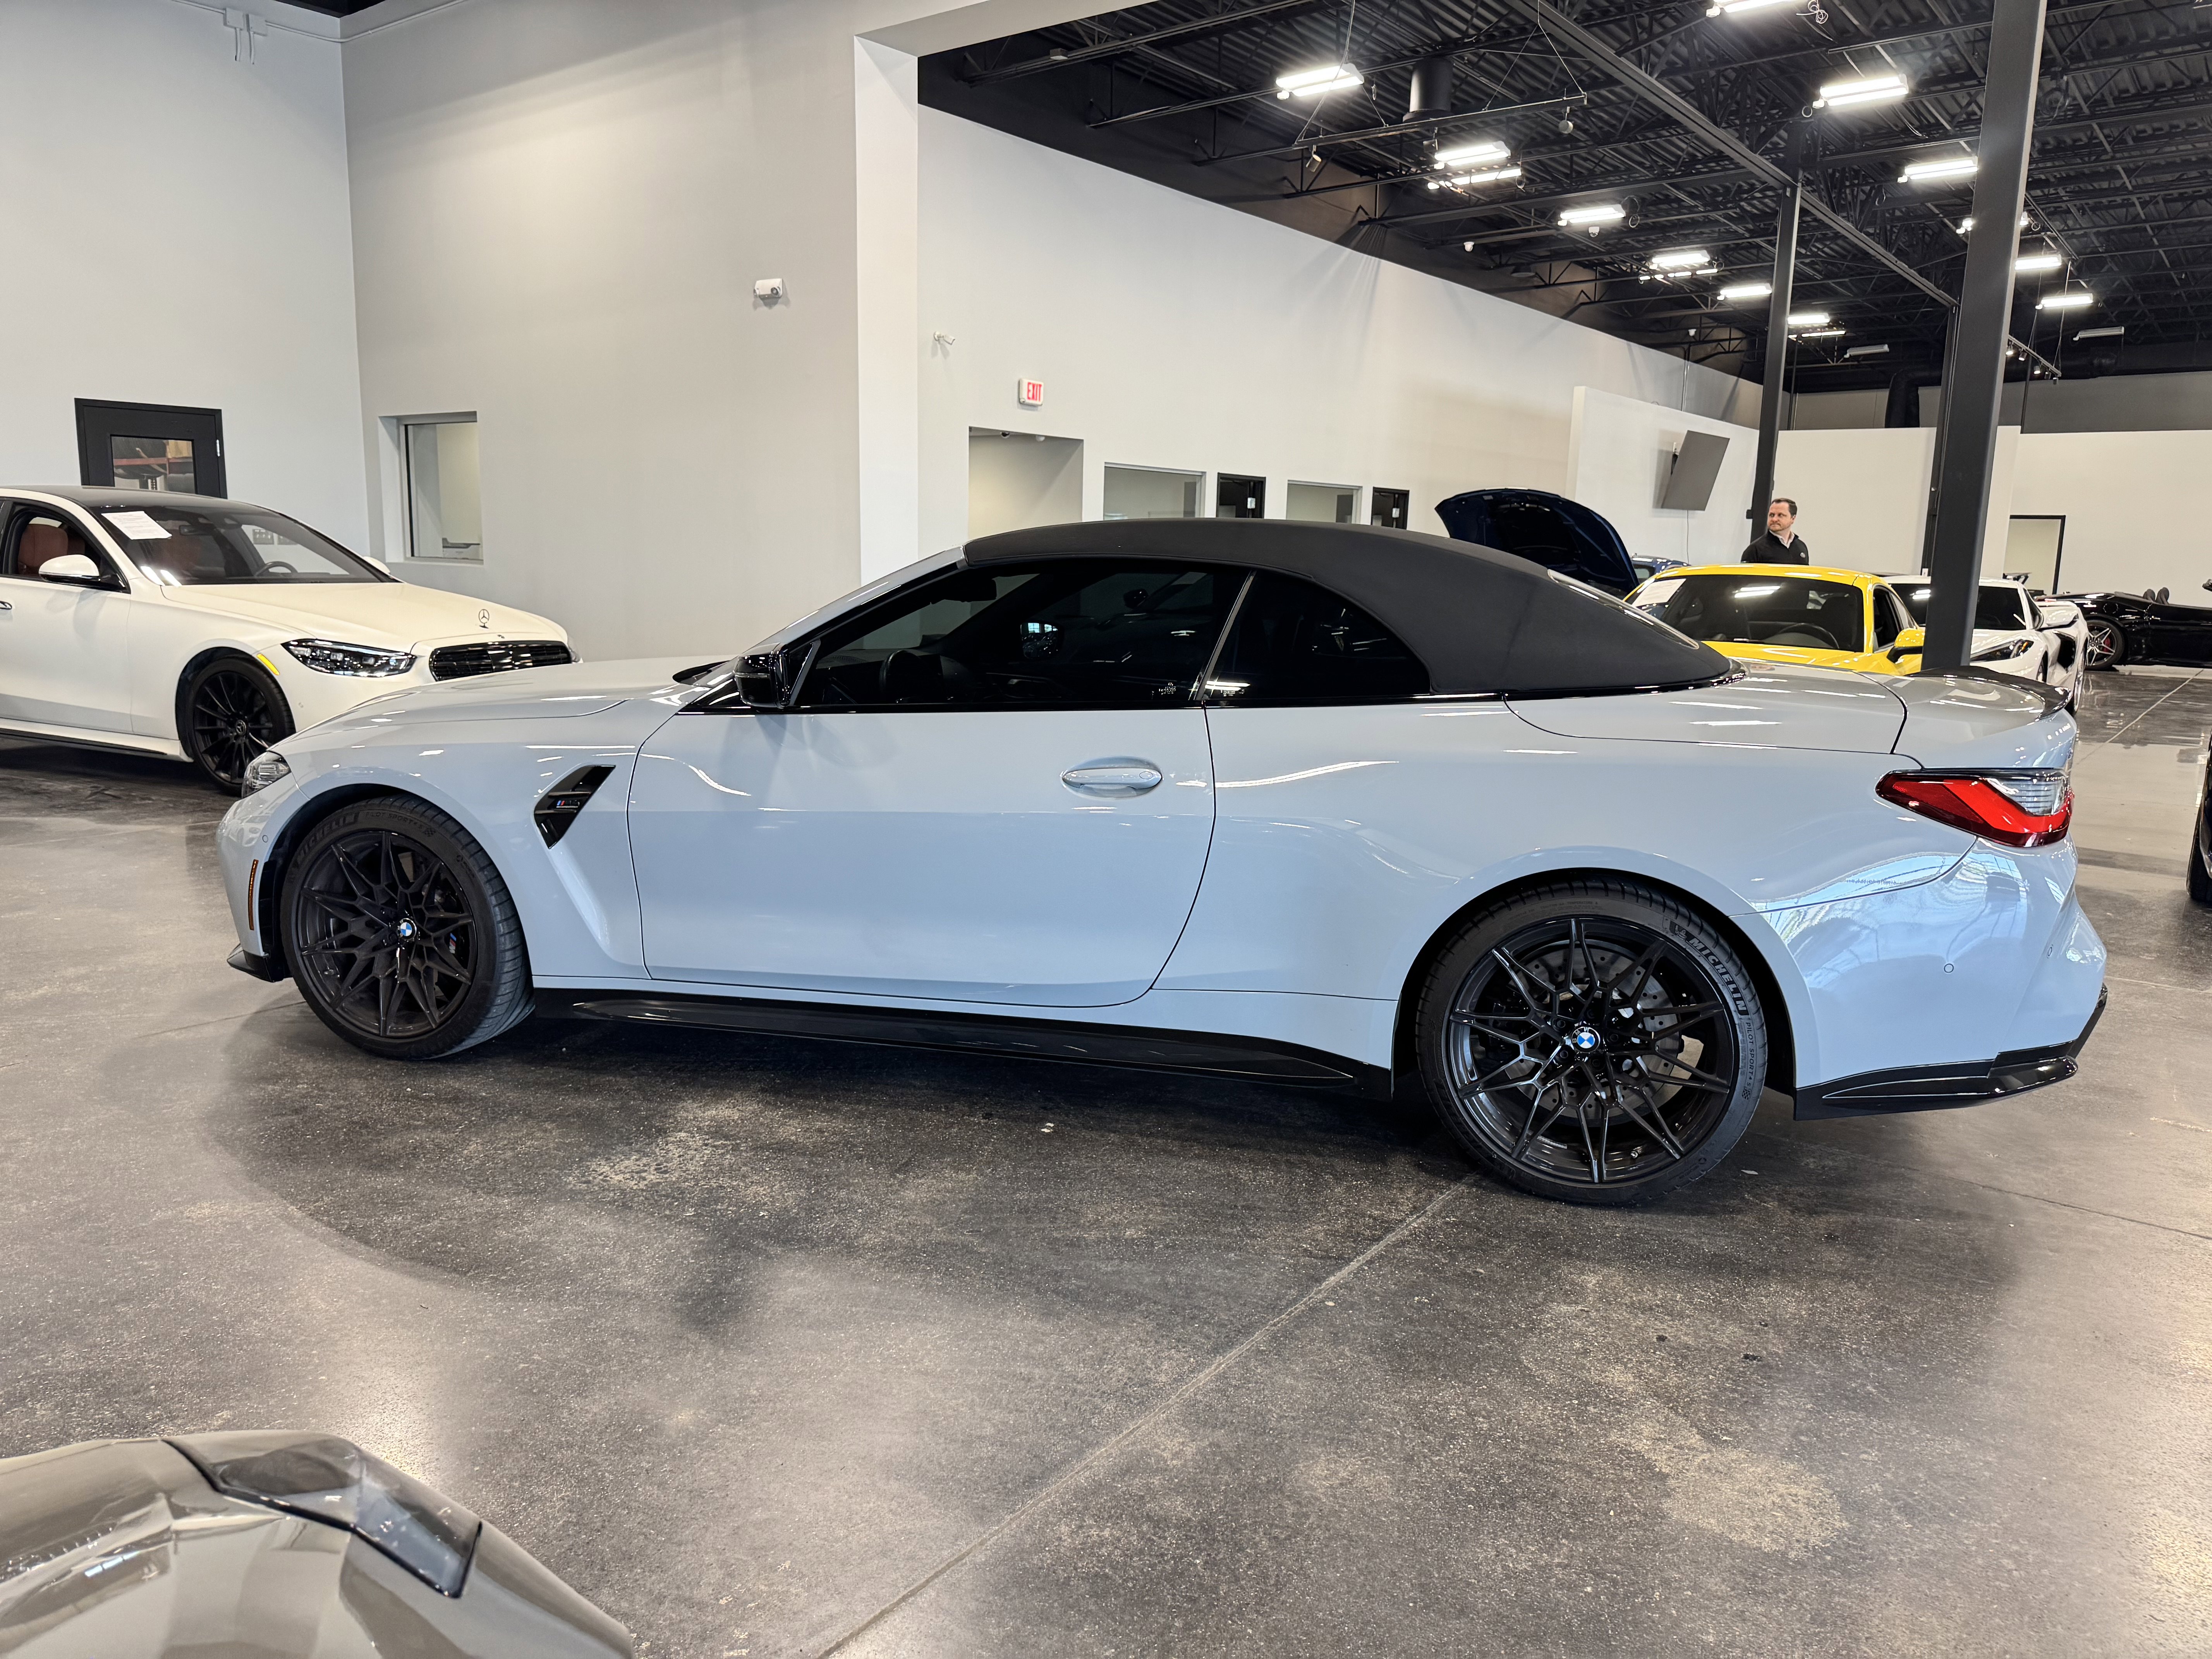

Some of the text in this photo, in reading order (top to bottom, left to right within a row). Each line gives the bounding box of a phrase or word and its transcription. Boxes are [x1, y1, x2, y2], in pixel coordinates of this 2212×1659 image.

[1027, 382, 1042, 402] EXIT
[388, 813, 414, 824] SPORT
[1688, 937, 1747, 1011] MICHELIN
[1572, 1027, 1590, 1043] BMW
[1745, 1022, 1753, 1044] PILOT
